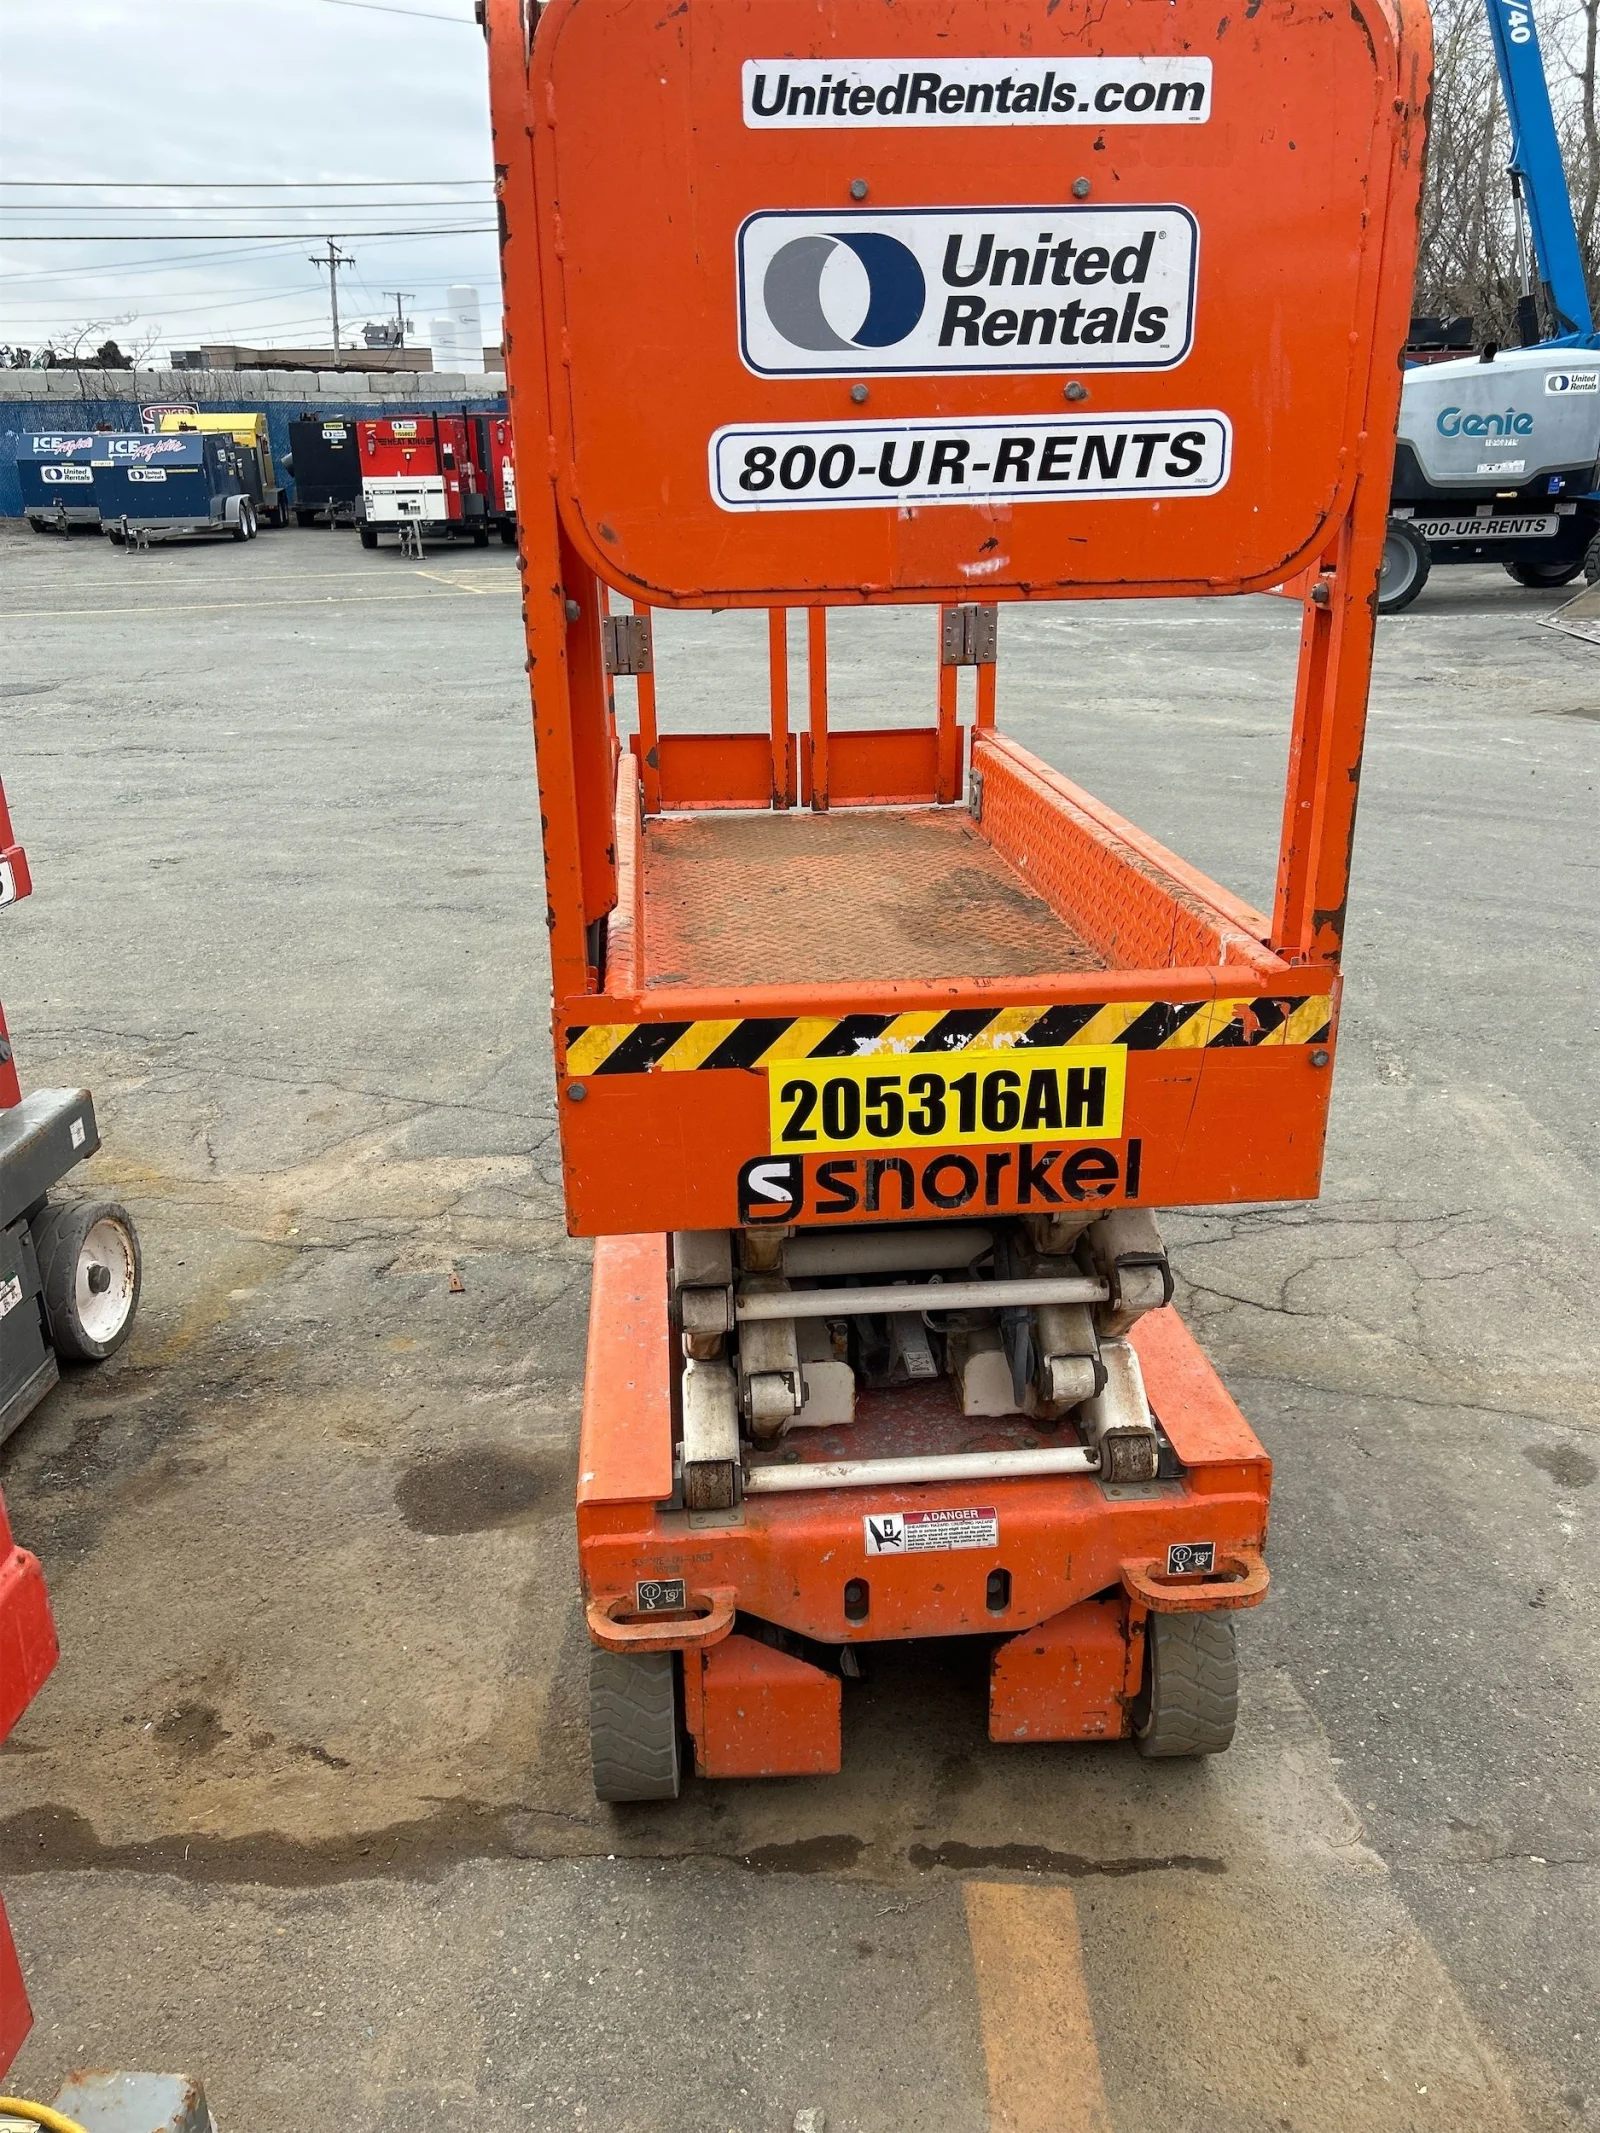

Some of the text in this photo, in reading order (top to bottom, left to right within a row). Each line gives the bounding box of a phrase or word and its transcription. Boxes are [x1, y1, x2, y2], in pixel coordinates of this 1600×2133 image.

[751, 71, 1205, 117] UnitedRentals.com
[942, 231, 1157, 287] United
[938, 293, 1169, 347] Rentals
[1570, 383, 1597, 391] Rentals
[1571, 374, 1597, 382] United
[1437, 407, 1534, 437] Genie
[33, 436, 63, 449] ICE
[107, 440, 140, 454] ICE
[739, 431, 1206, 492] 800-UR-RENTS
[780, 1065, 1107, 1143] 205316AH
[815, 1138, 1142, 1214] snorkel
[931, 1510, 979, 1521] DANGER
